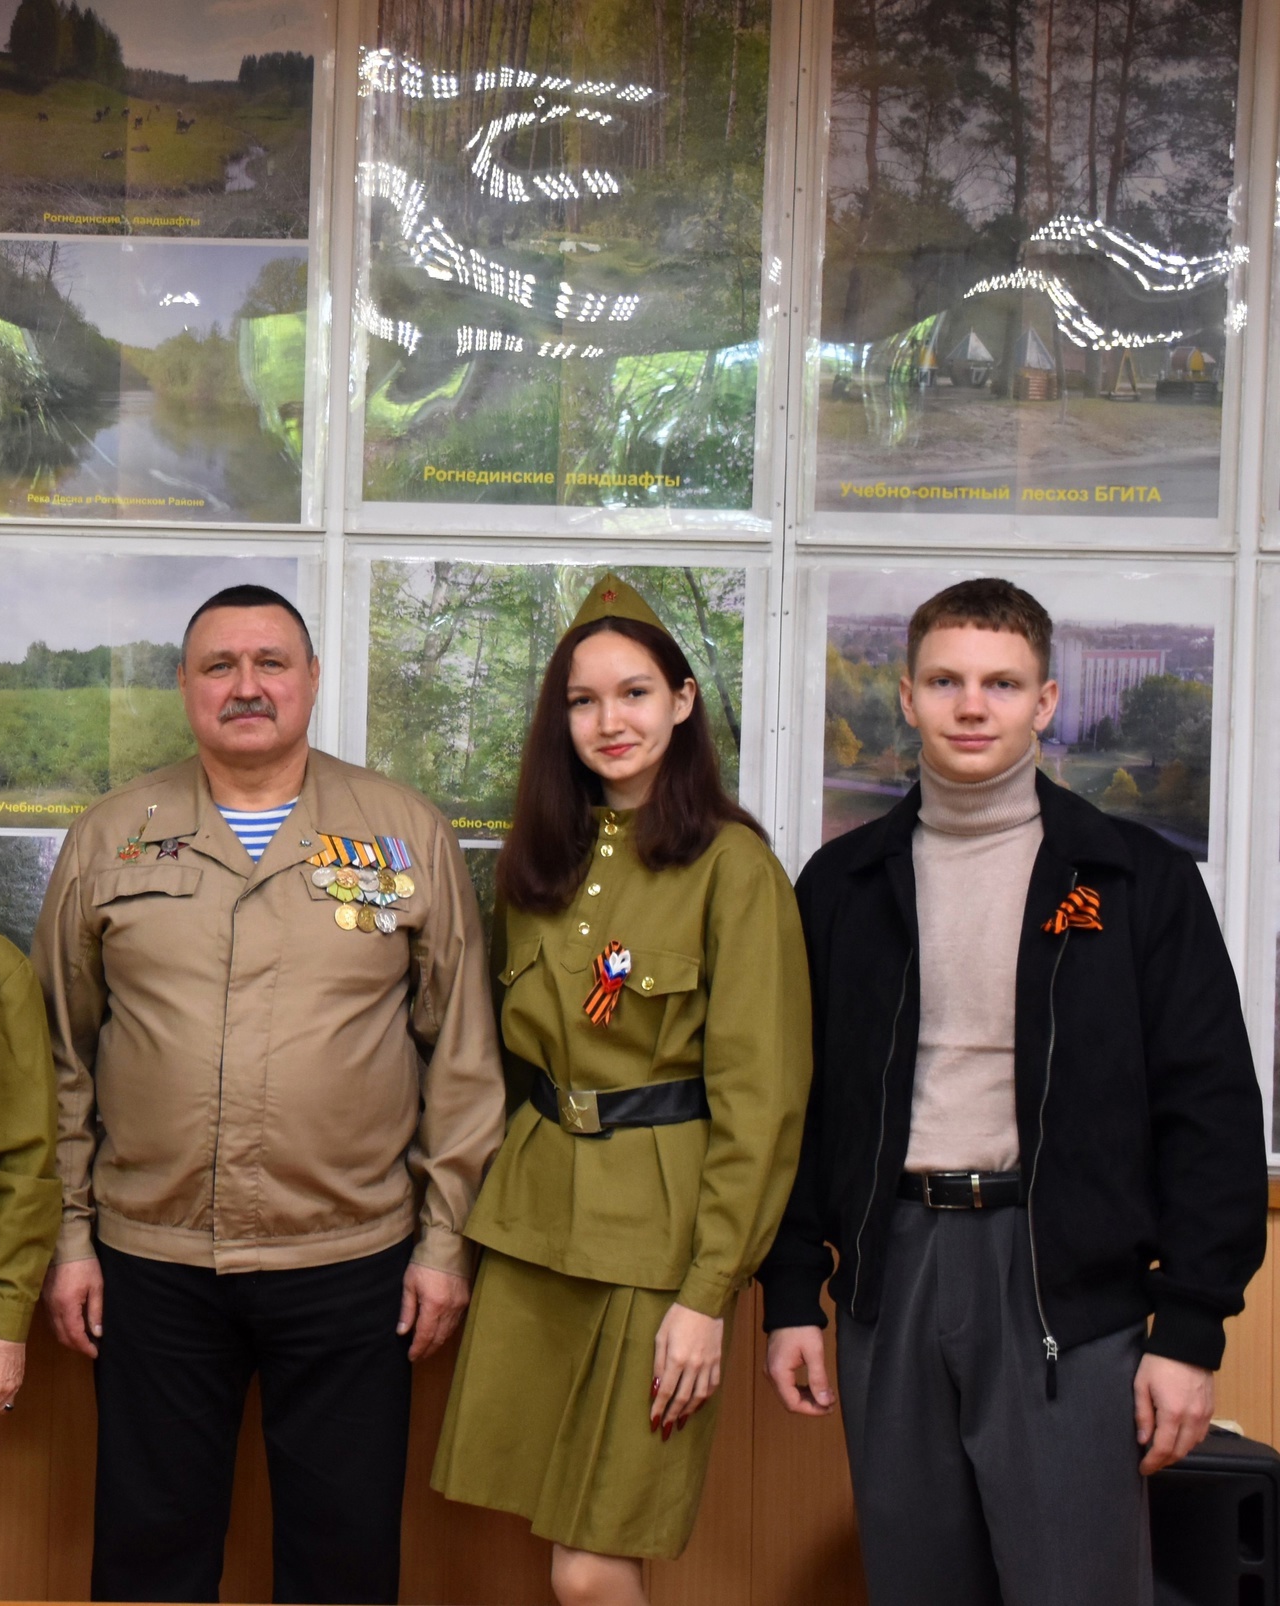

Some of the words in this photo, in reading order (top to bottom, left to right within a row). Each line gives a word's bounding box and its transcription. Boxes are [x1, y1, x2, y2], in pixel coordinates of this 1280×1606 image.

[43, 212, 120, 224] Рогнединские
[132, 216, 200, 227] ландшафты
[423, 466, 555, 484] Рогнединские
[564, 471, 680, 488] ландшафты
[27, 493, 50, 503] Река
[168, 497, 205, 506] Районе
[840, 482, 1010, 500] Учебно-опытный
[1022, 488, 1089, 501] лесхоз
[1095, 486, 1161, 502] БГИТА
[451, 817, 515, 829] ебно-опы
